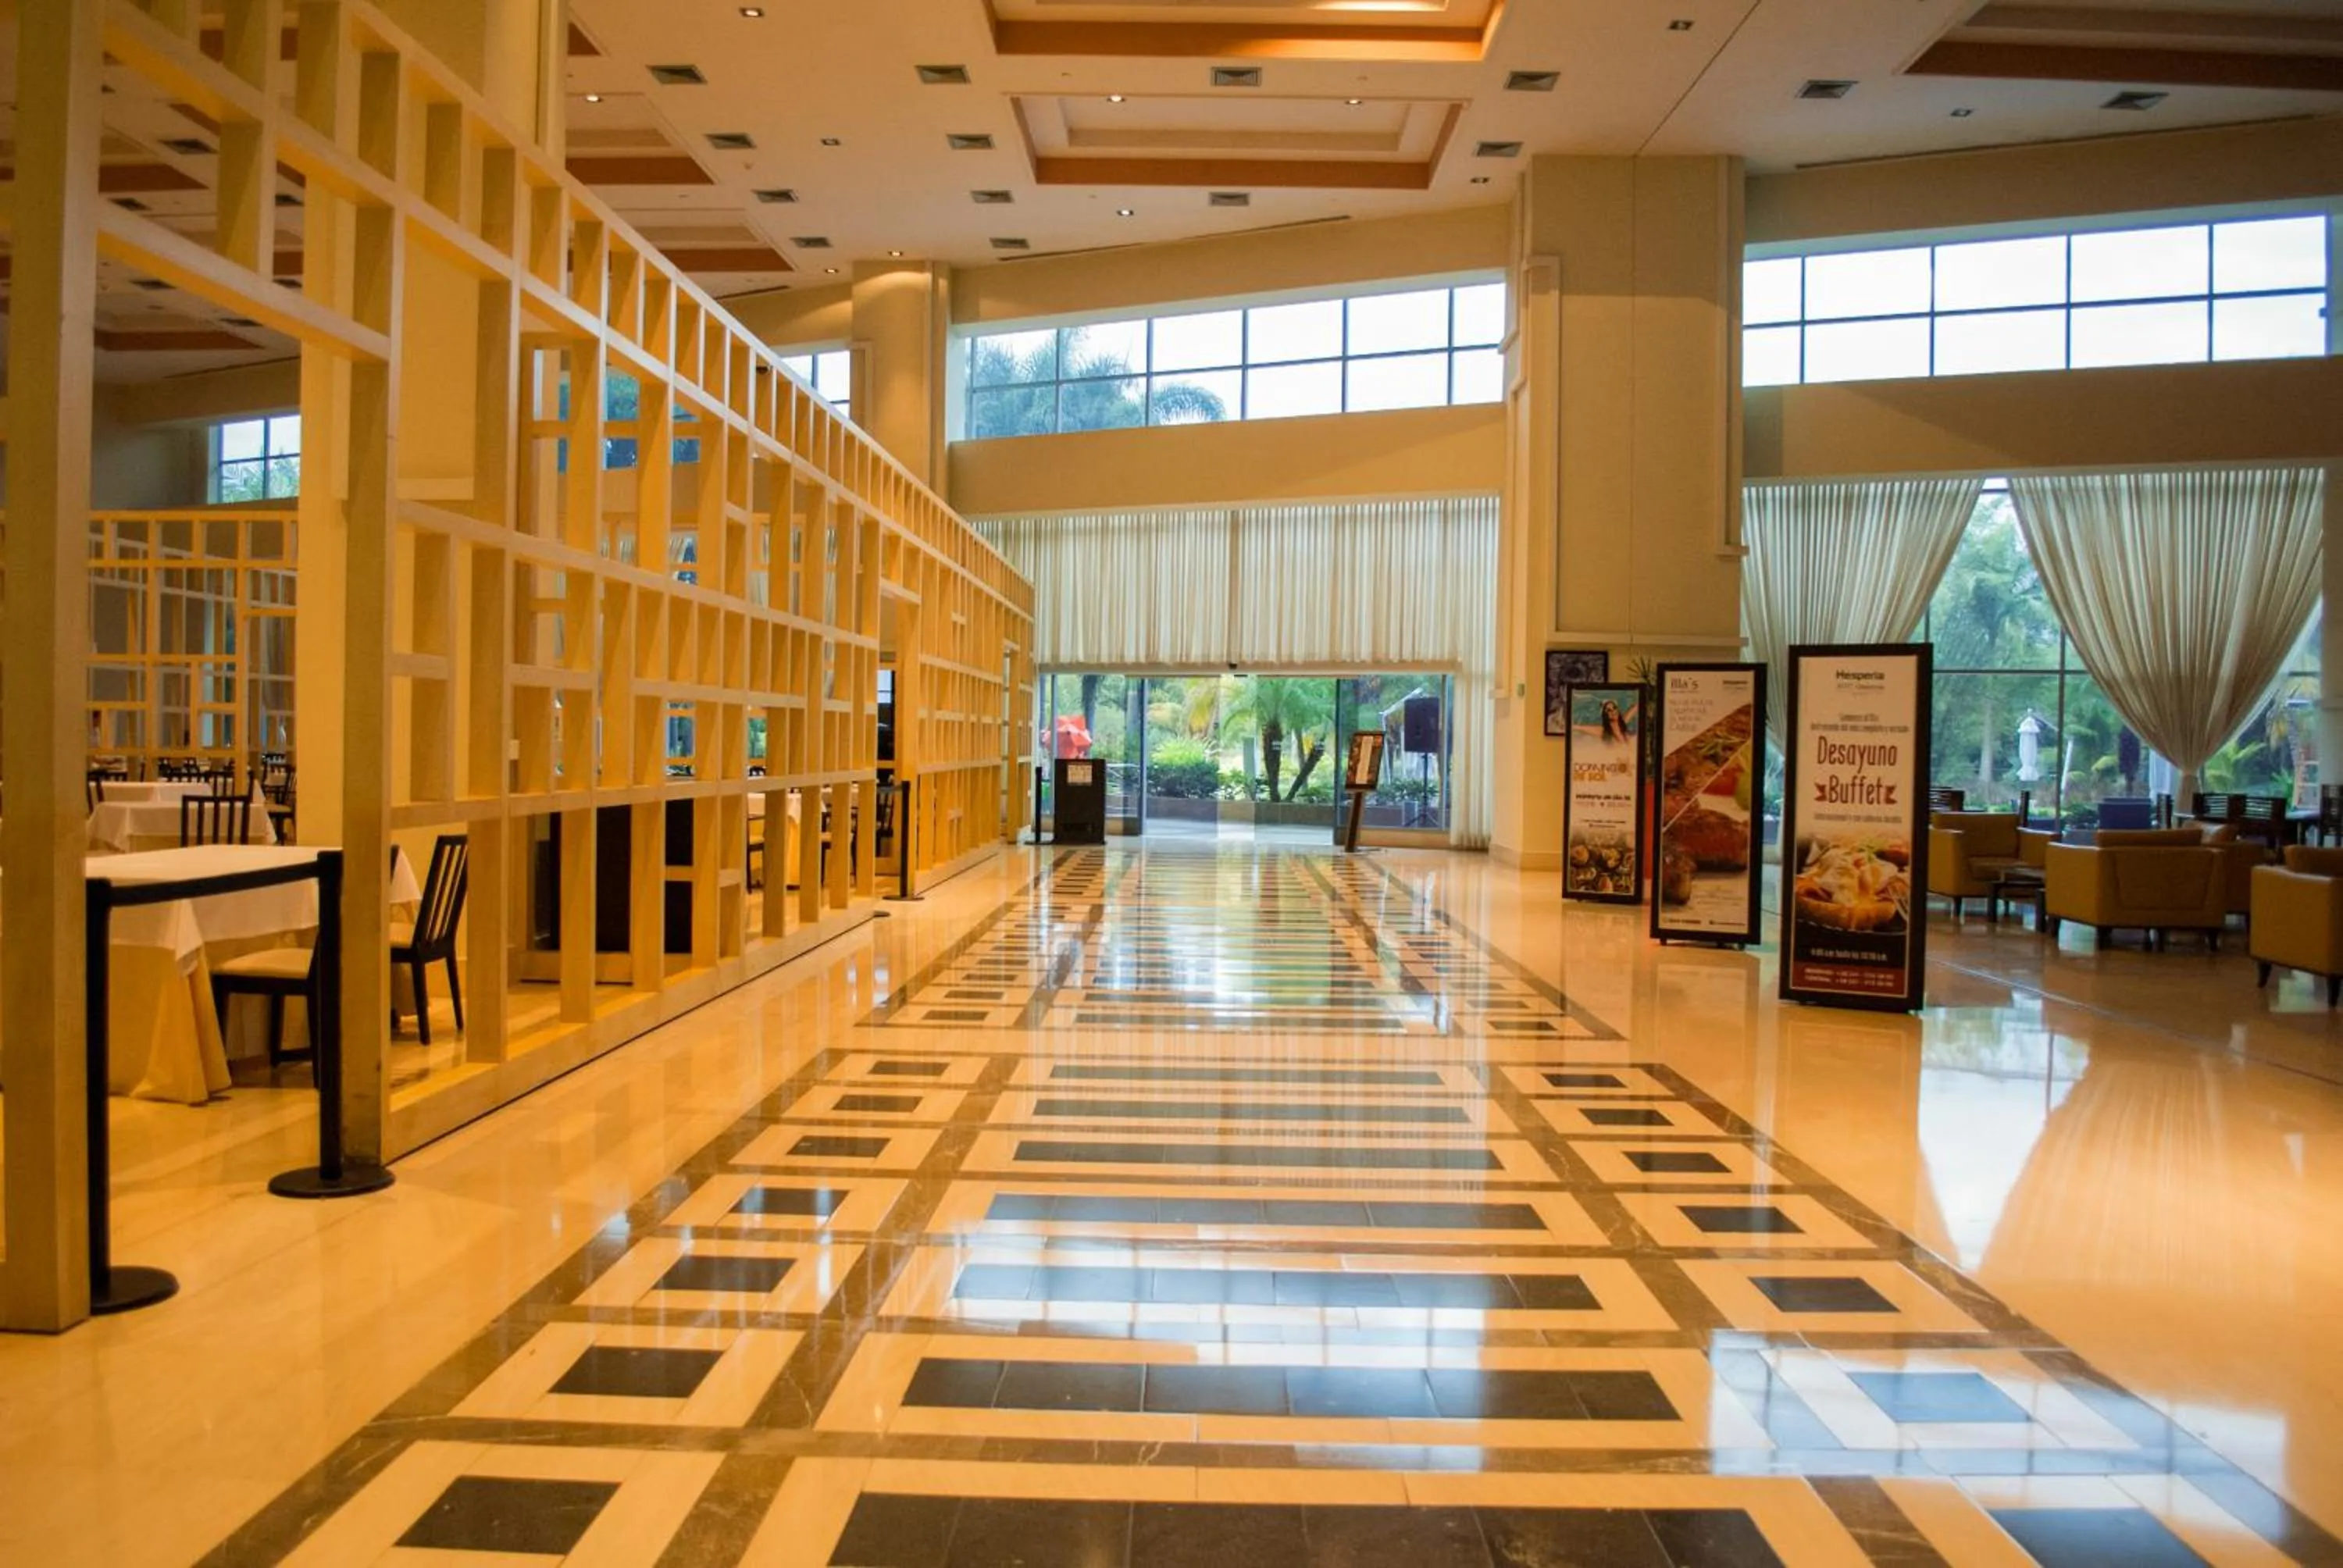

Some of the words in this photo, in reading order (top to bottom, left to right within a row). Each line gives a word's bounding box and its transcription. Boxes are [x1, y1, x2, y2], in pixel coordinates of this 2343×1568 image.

[1835, 670, 1885, 682] Hesperia
[1817, 736, 1899, 774] Desayuno
[1828, 775, 1883, 805] Buffet
